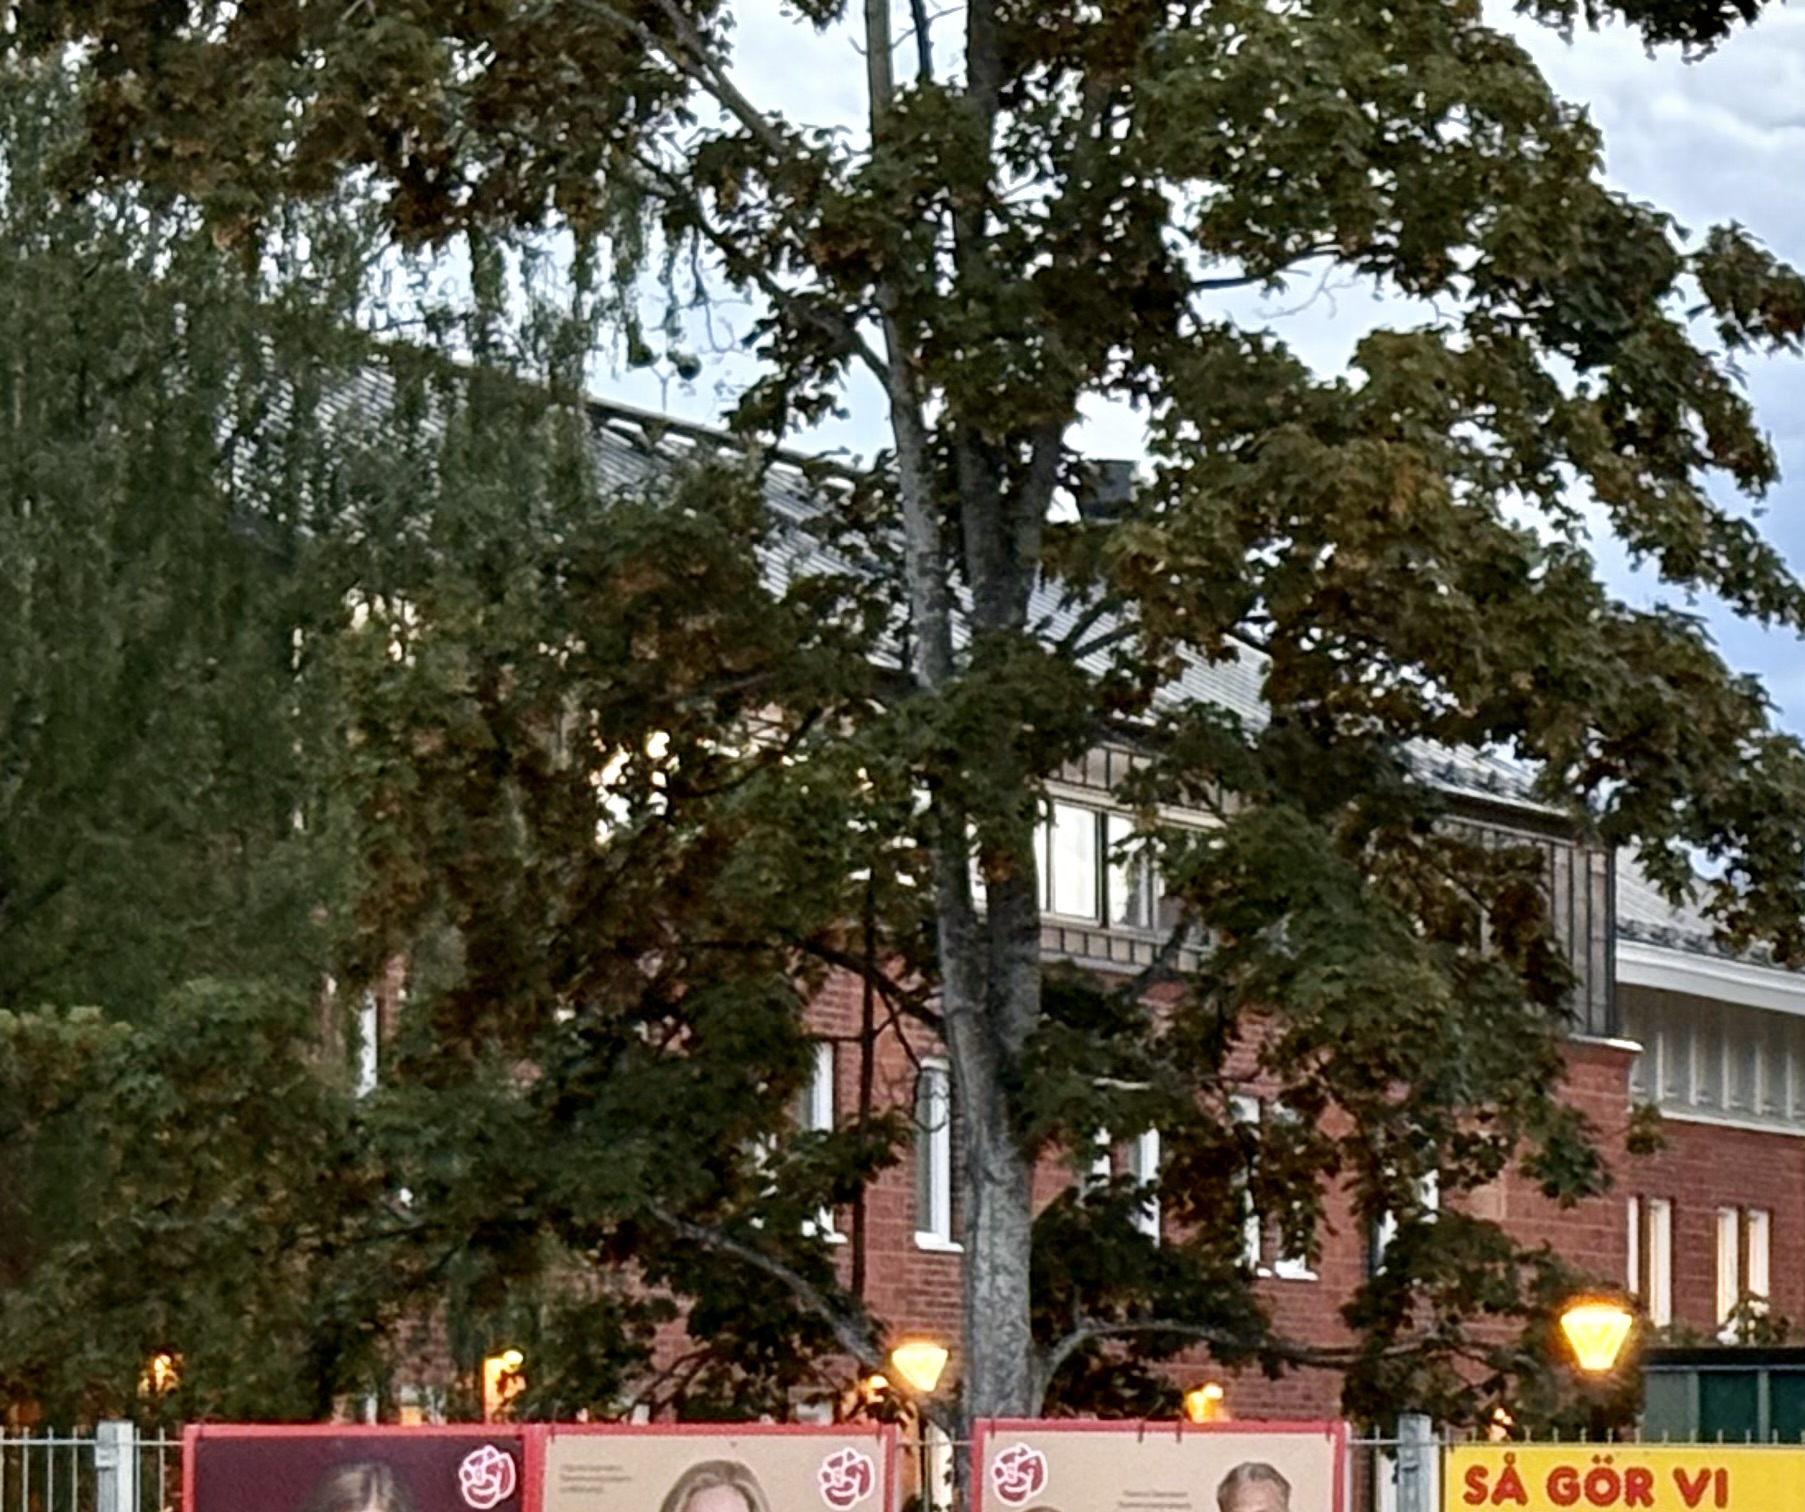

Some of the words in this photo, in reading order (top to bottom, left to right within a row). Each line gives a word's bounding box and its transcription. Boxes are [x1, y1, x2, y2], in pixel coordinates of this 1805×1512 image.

[1463, 1452, 1529, 1506] SÅ
[1546, 1454, 1655, 1508] GÖR
[1672, 1467, 1728, 1508] VI
